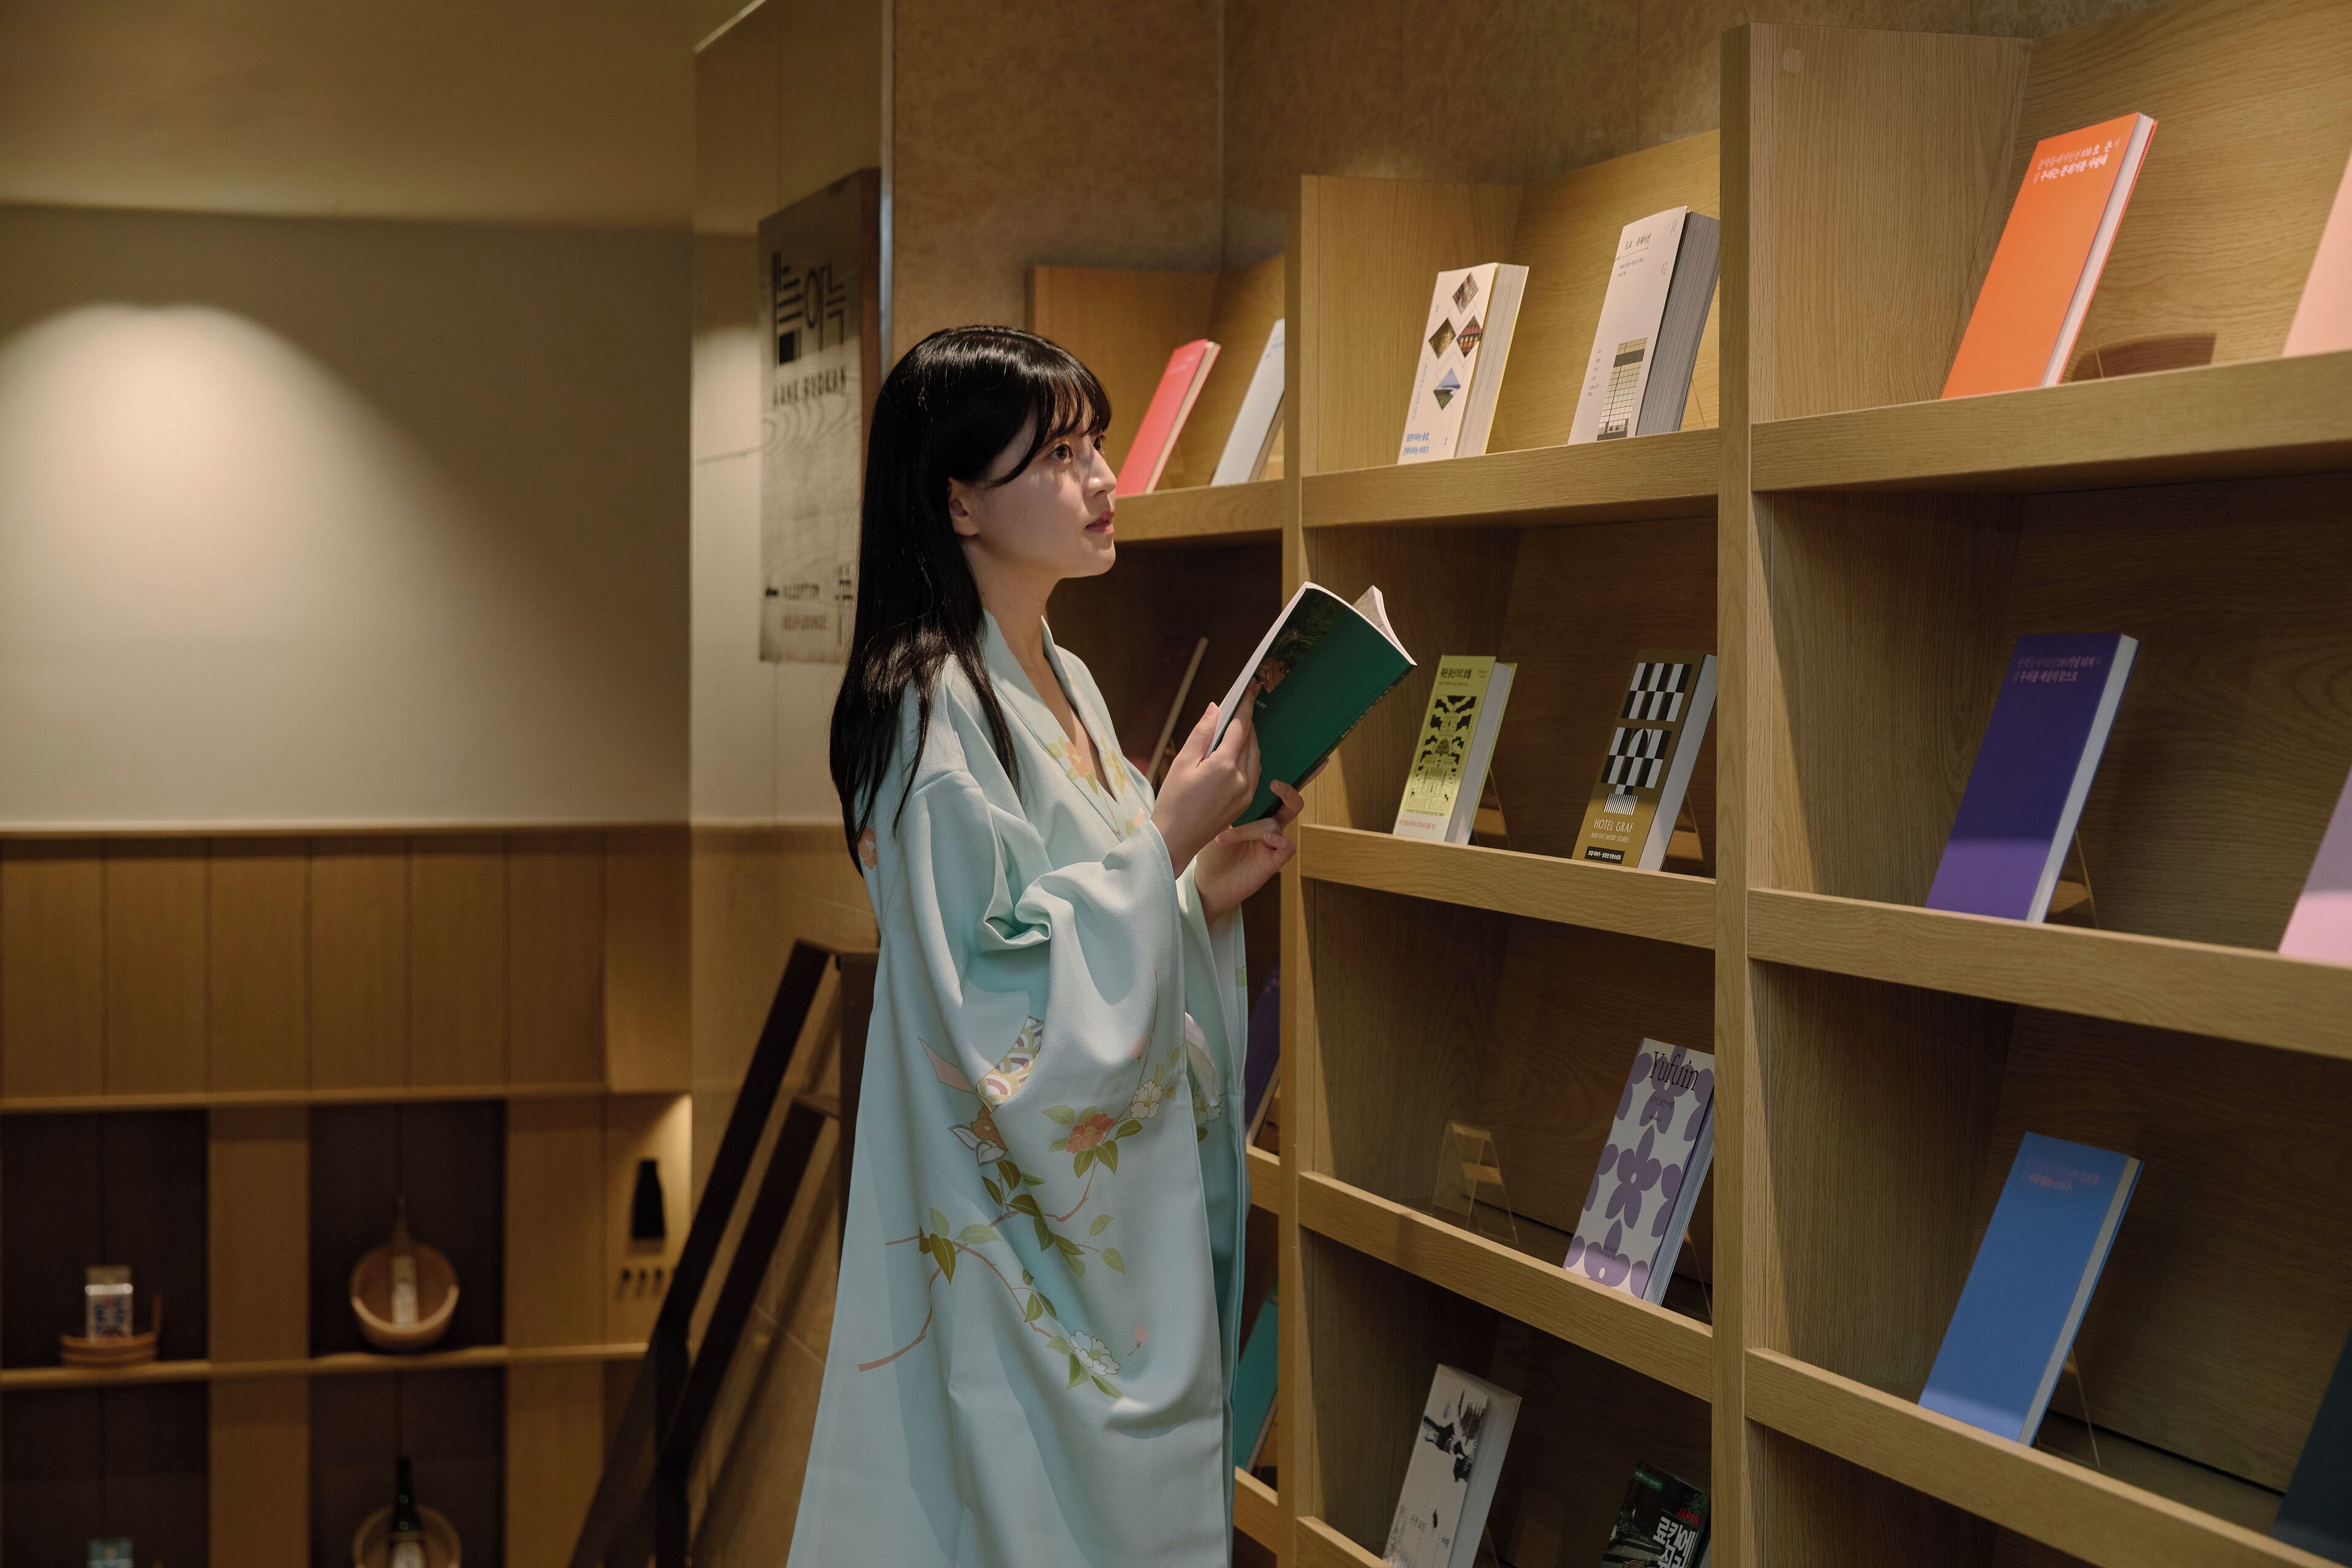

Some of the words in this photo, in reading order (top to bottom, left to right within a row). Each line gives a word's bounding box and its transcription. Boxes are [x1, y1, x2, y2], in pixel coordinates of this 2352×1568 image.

[2040, 167, 2060, 182] 우리는
[1594, 818, 1614, 831] HOTEL
[1616, 821, 1634, 833] GRAF
[1616, 835, 1630, 843] STORIES
[1649, 1051, 1698, 1091] Yufuin
[1676, 1506, 1701, 1527] JAPAN
[1653, 1516, 1696, 1557] 료칸에
